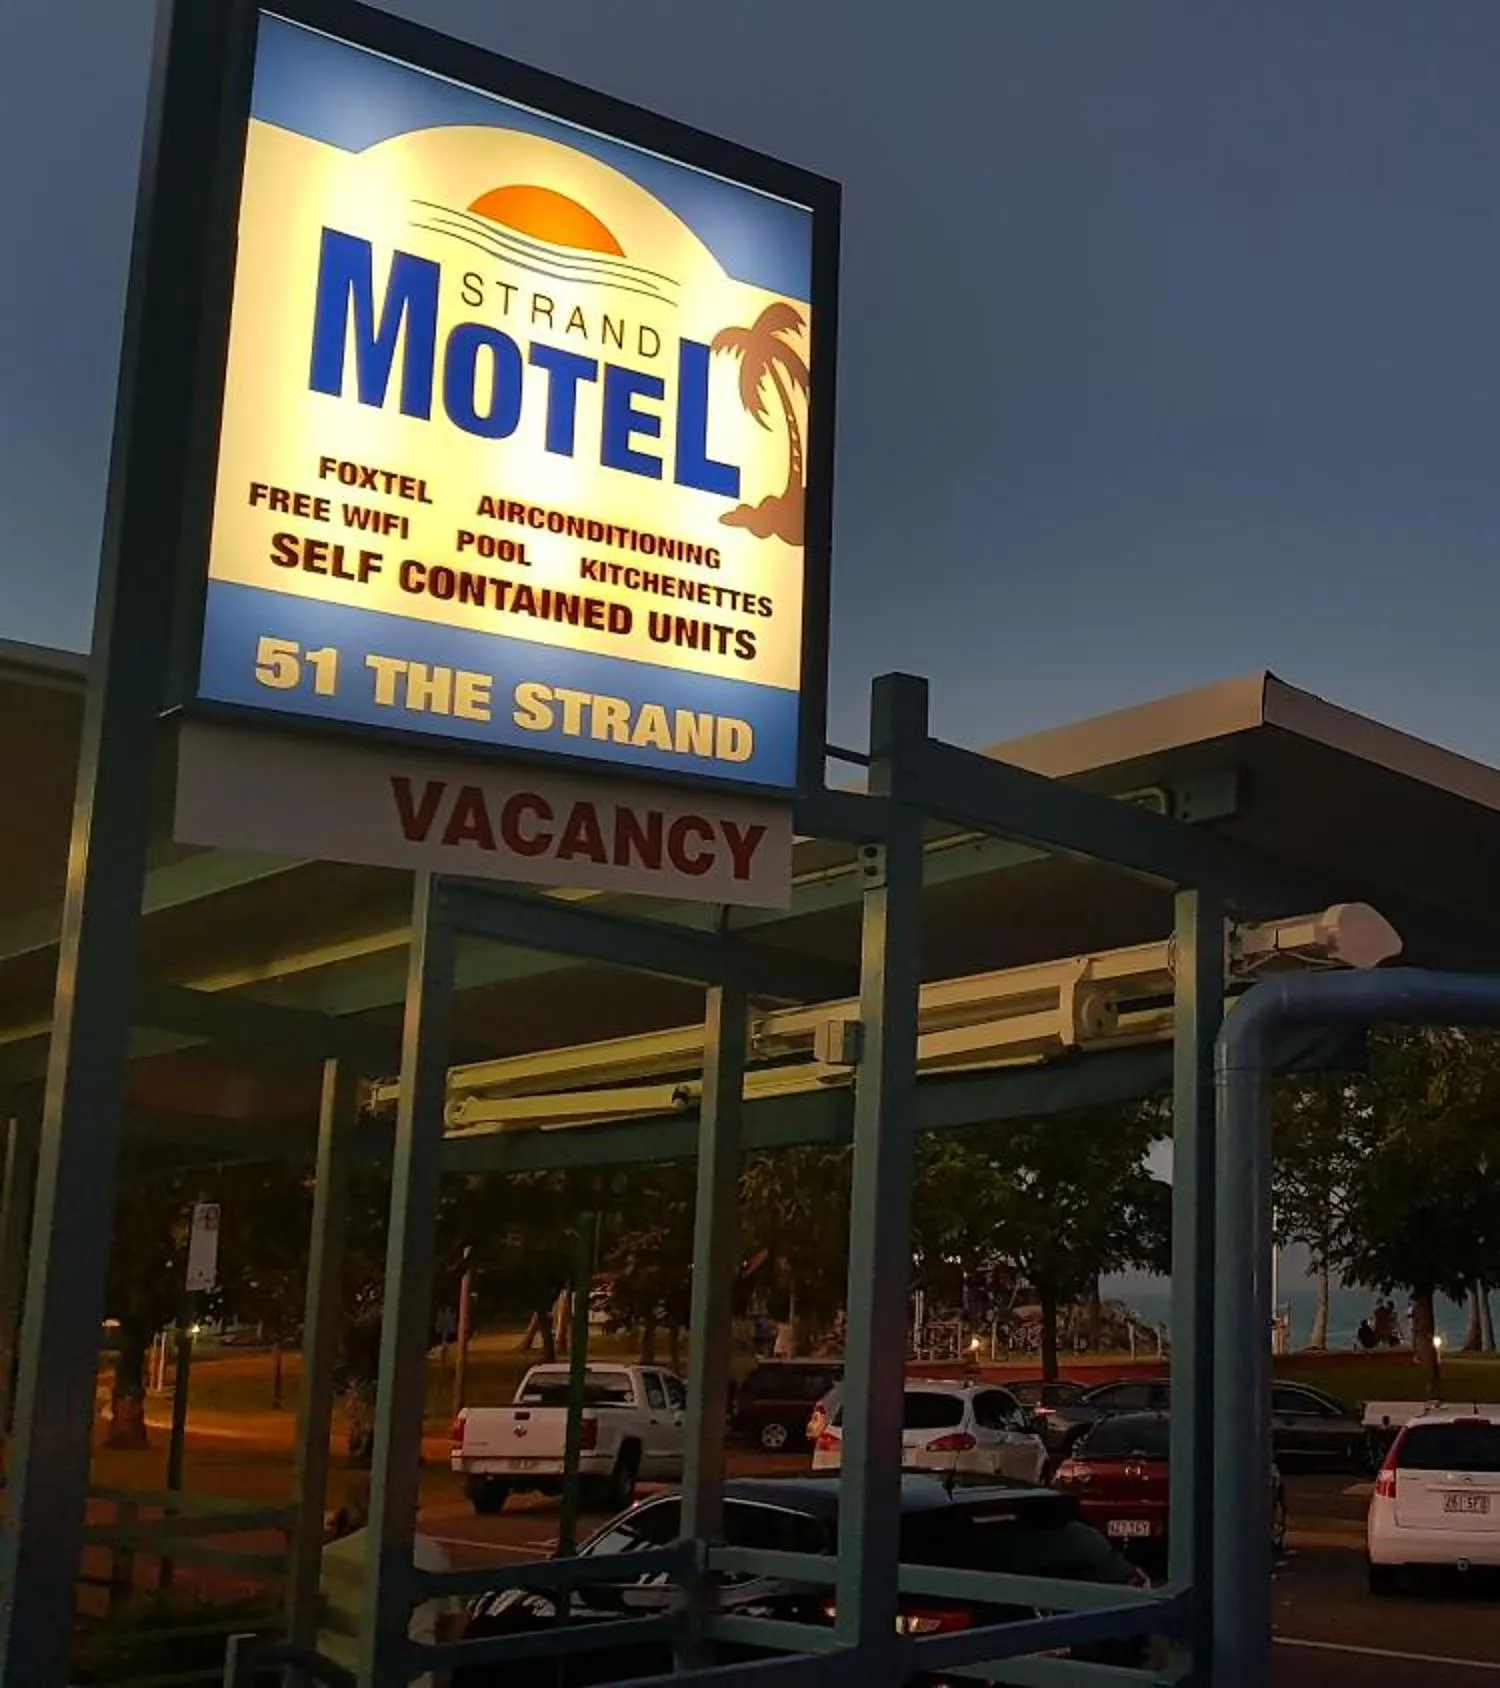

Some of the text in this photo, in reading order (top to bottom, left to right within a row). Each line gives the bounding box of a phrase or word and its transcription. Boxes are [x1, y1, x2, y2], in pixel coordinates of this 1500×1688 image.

[460, 271, 661, 359] STRAND
[308, 225, 741, 498] MOTEL
[248, 481, 409, 540] FREE WIFI
[318, 455, 433, 505] FOXTEL
[456, 529, 532, 568] POOL
[476, 495, 721, 570] AIRCONDITIONING
[269, 532, 757, 661] SELF CONTAINED UNITS
[580, 557, 773, 618] KITCHENETTES
[254, 636, 754, 763] 51 THE STRAND
[390, 776, 768, 881] VACANCY
